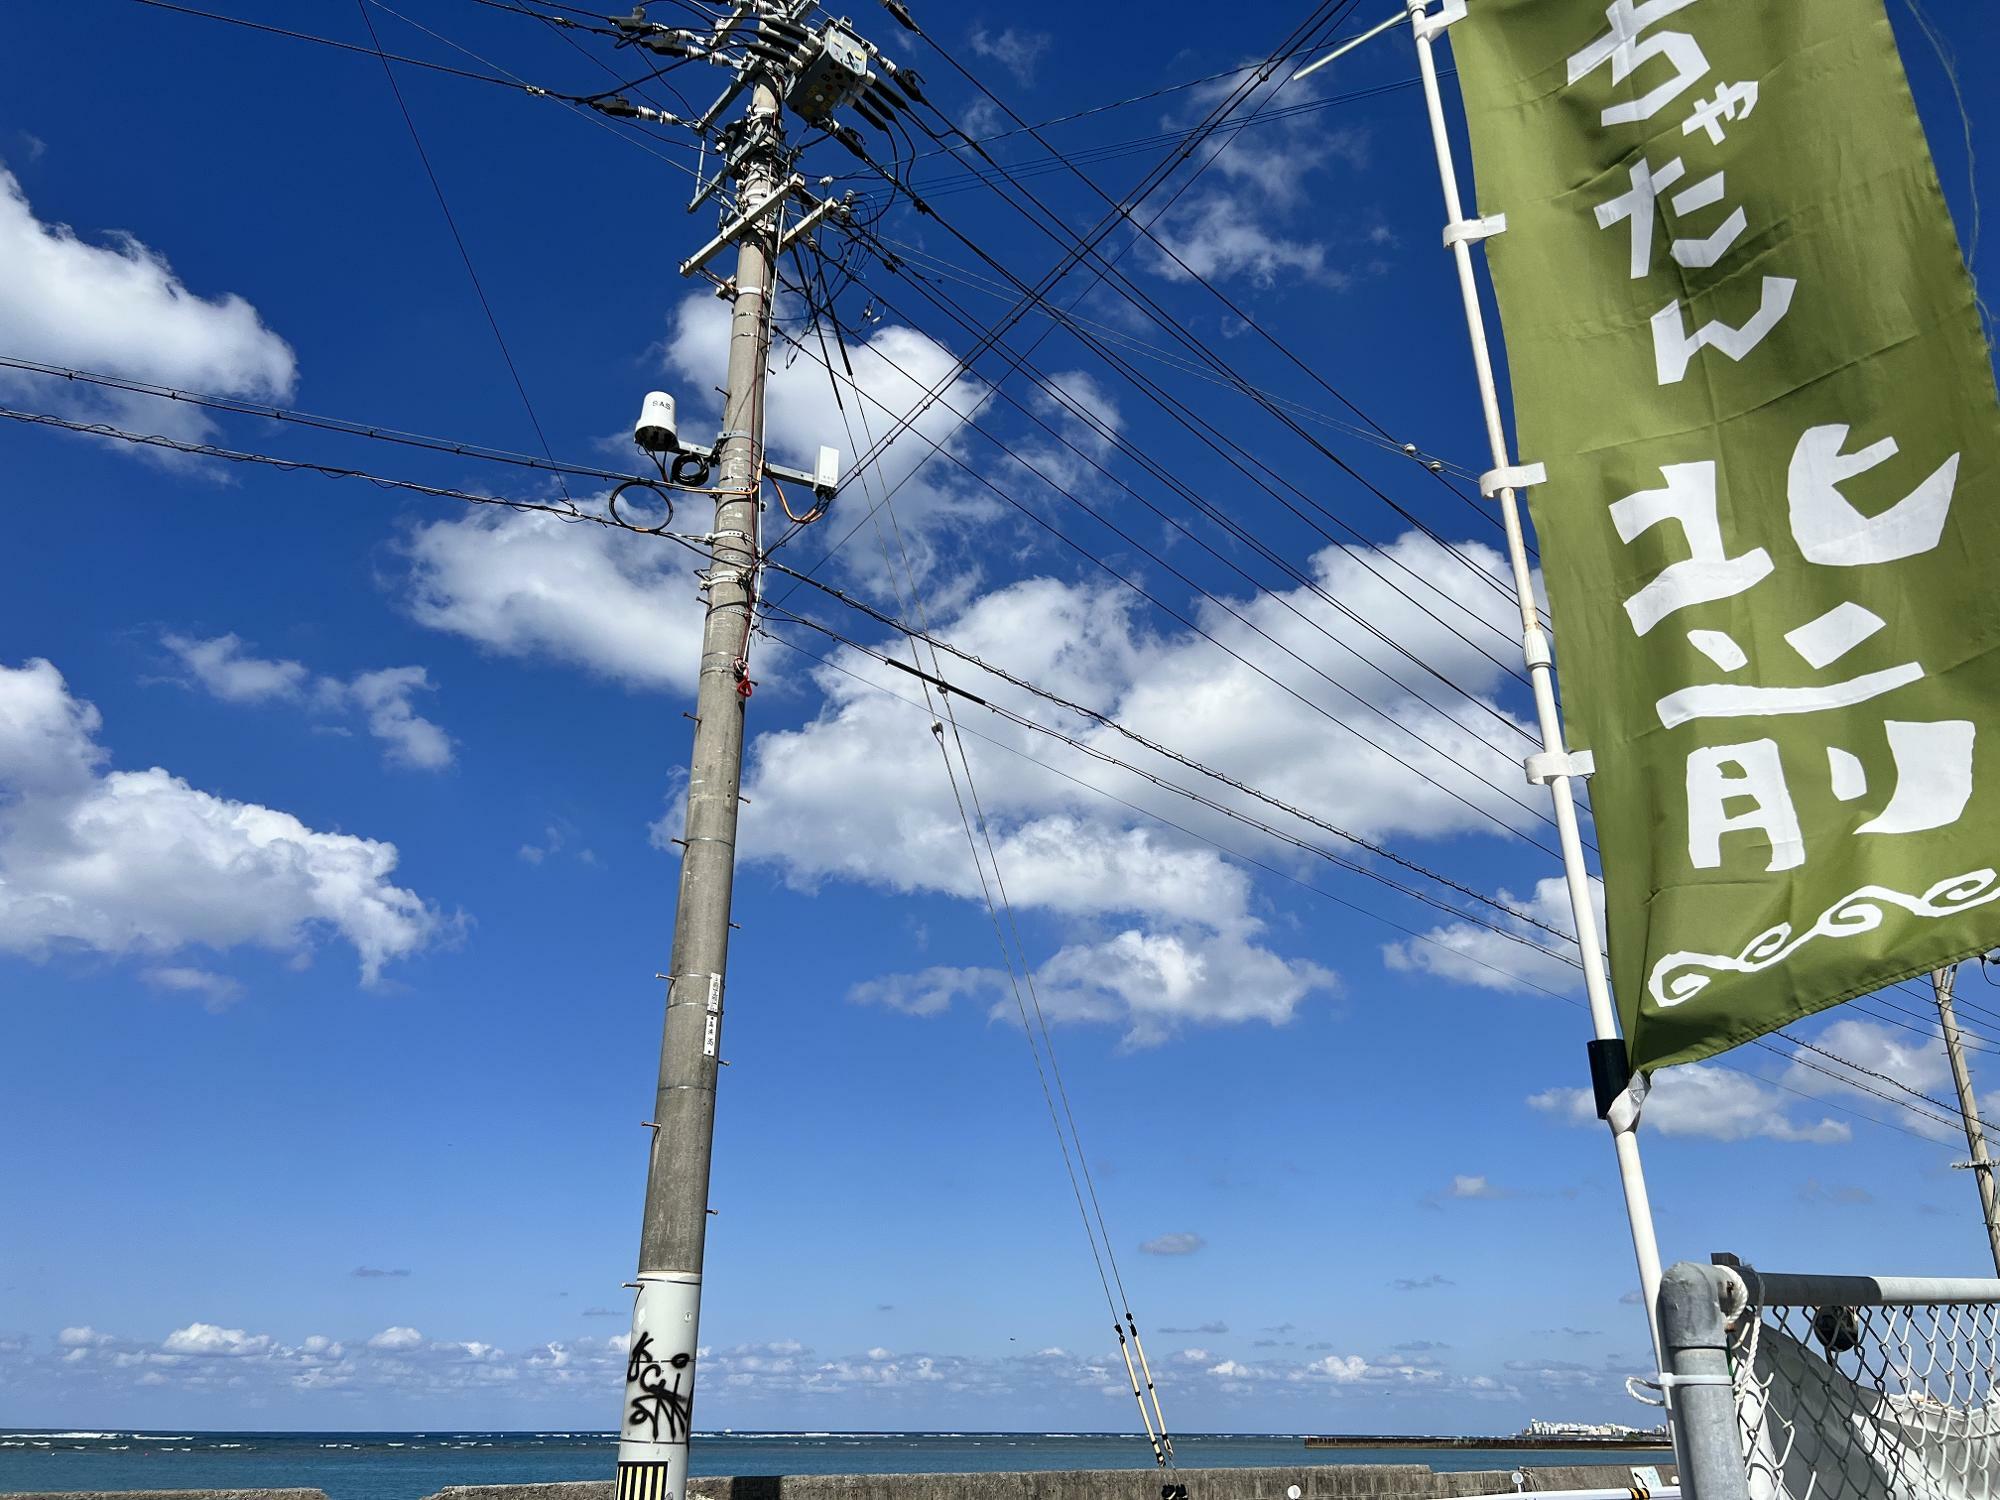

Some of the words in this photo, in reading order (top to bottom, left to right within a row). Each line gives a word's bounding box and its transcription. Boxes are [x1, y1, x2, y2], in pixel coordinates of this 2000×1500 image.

[1567, 0, 1797, 385] ちゃたん
[1609, 423, 1976, 873] 北前
